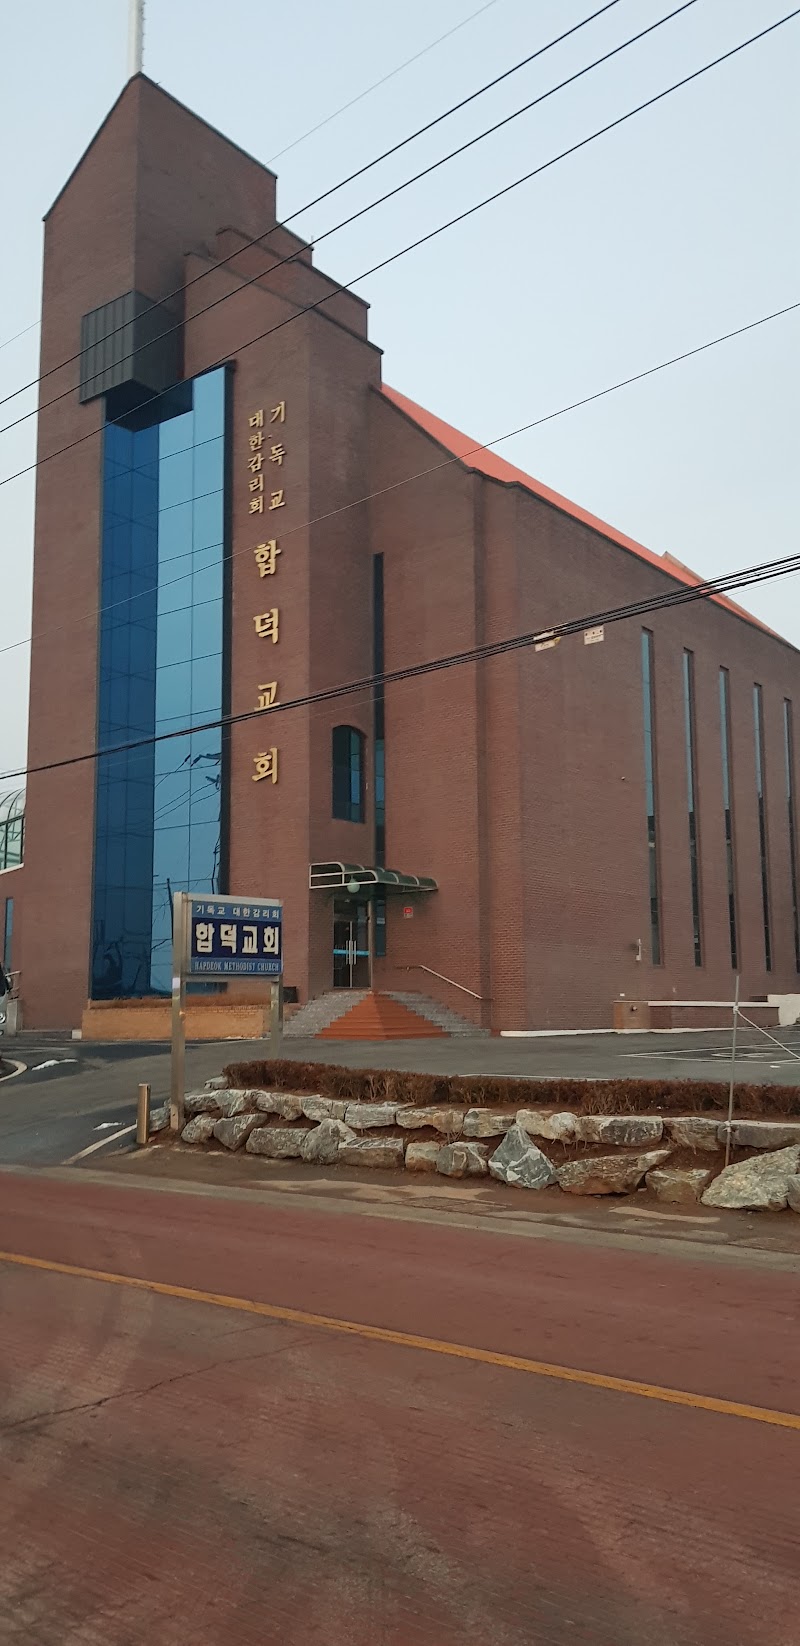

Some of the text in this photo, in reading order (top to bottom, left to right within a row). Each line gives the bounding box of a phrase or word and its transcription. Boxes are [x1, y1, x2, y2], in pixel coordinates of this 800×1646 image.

[247, 409, 265, 515] 대한감리회
[269, 400, 286, 511] 기독교
[251, 539, 281, 784] 합덕교회
[195, 922, 279, 955] 합덕교회
[196, 905, 279, 919] 기독교 대한감리회
[194, 961, 279, 972] HAPDEOK METHODIST CHURCH
